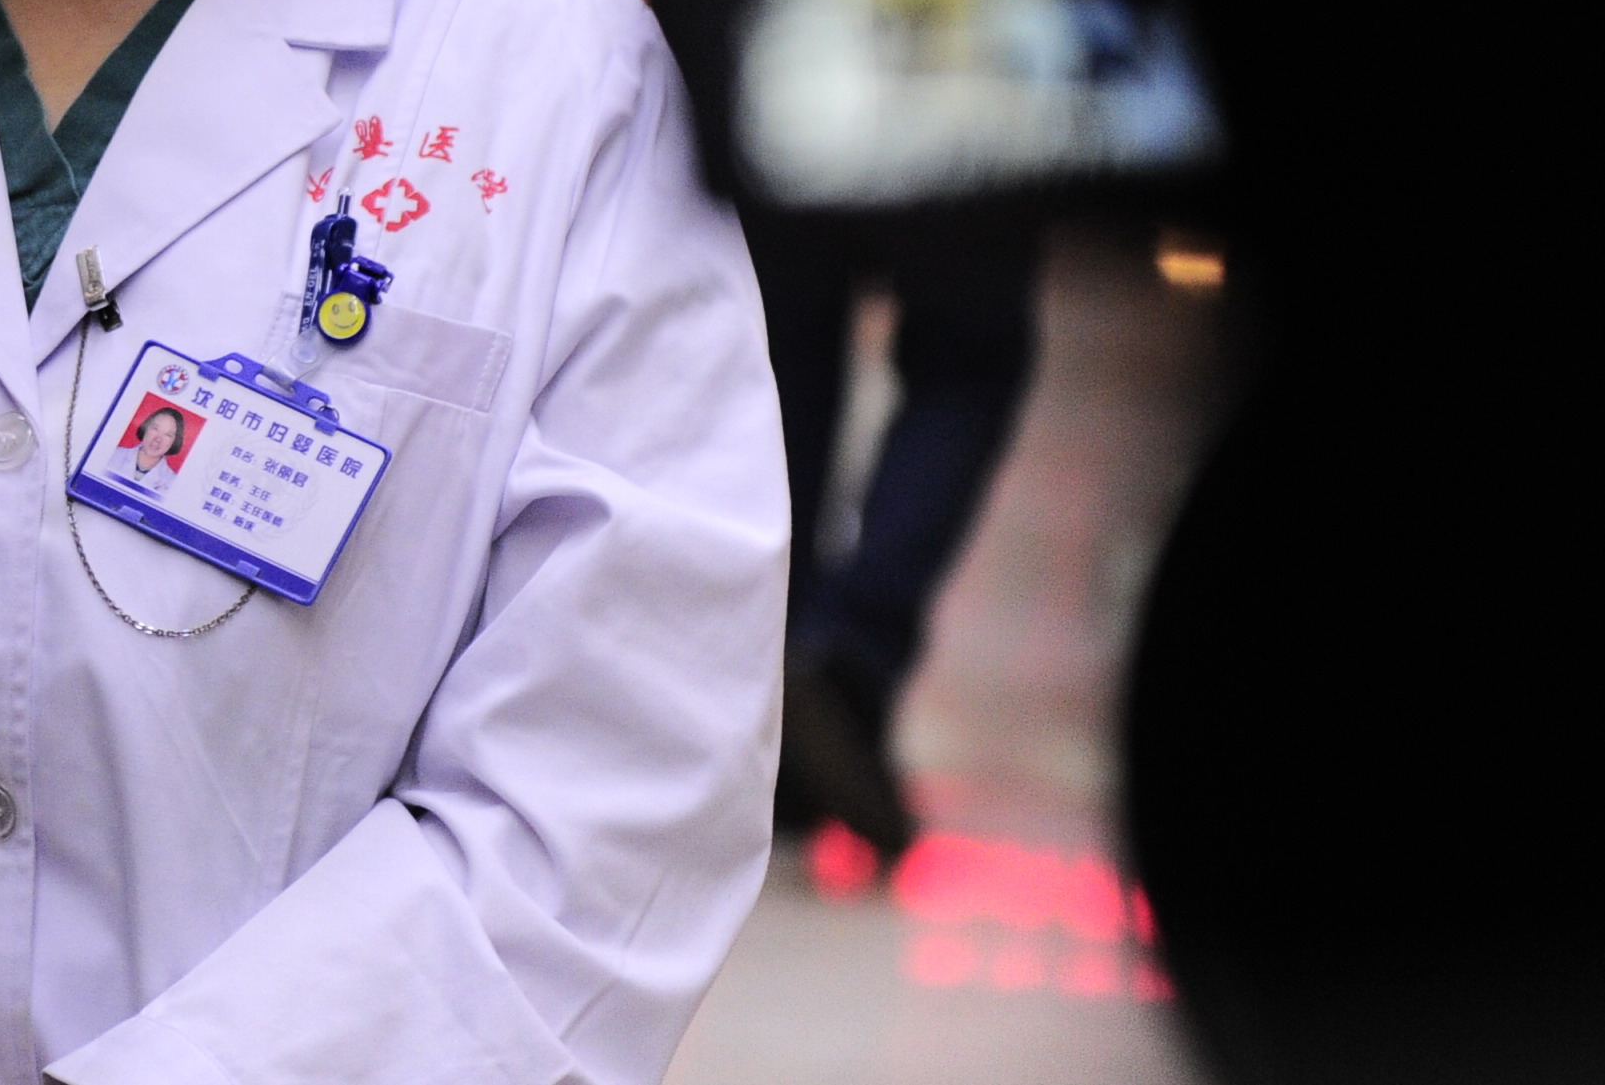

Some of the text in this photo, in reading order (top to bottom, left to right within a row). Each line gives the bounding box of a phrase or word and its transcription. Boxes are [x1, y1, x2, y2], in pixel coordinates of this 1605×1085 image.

[191, 387, 364, 479] 沈阳市妇婴医院
